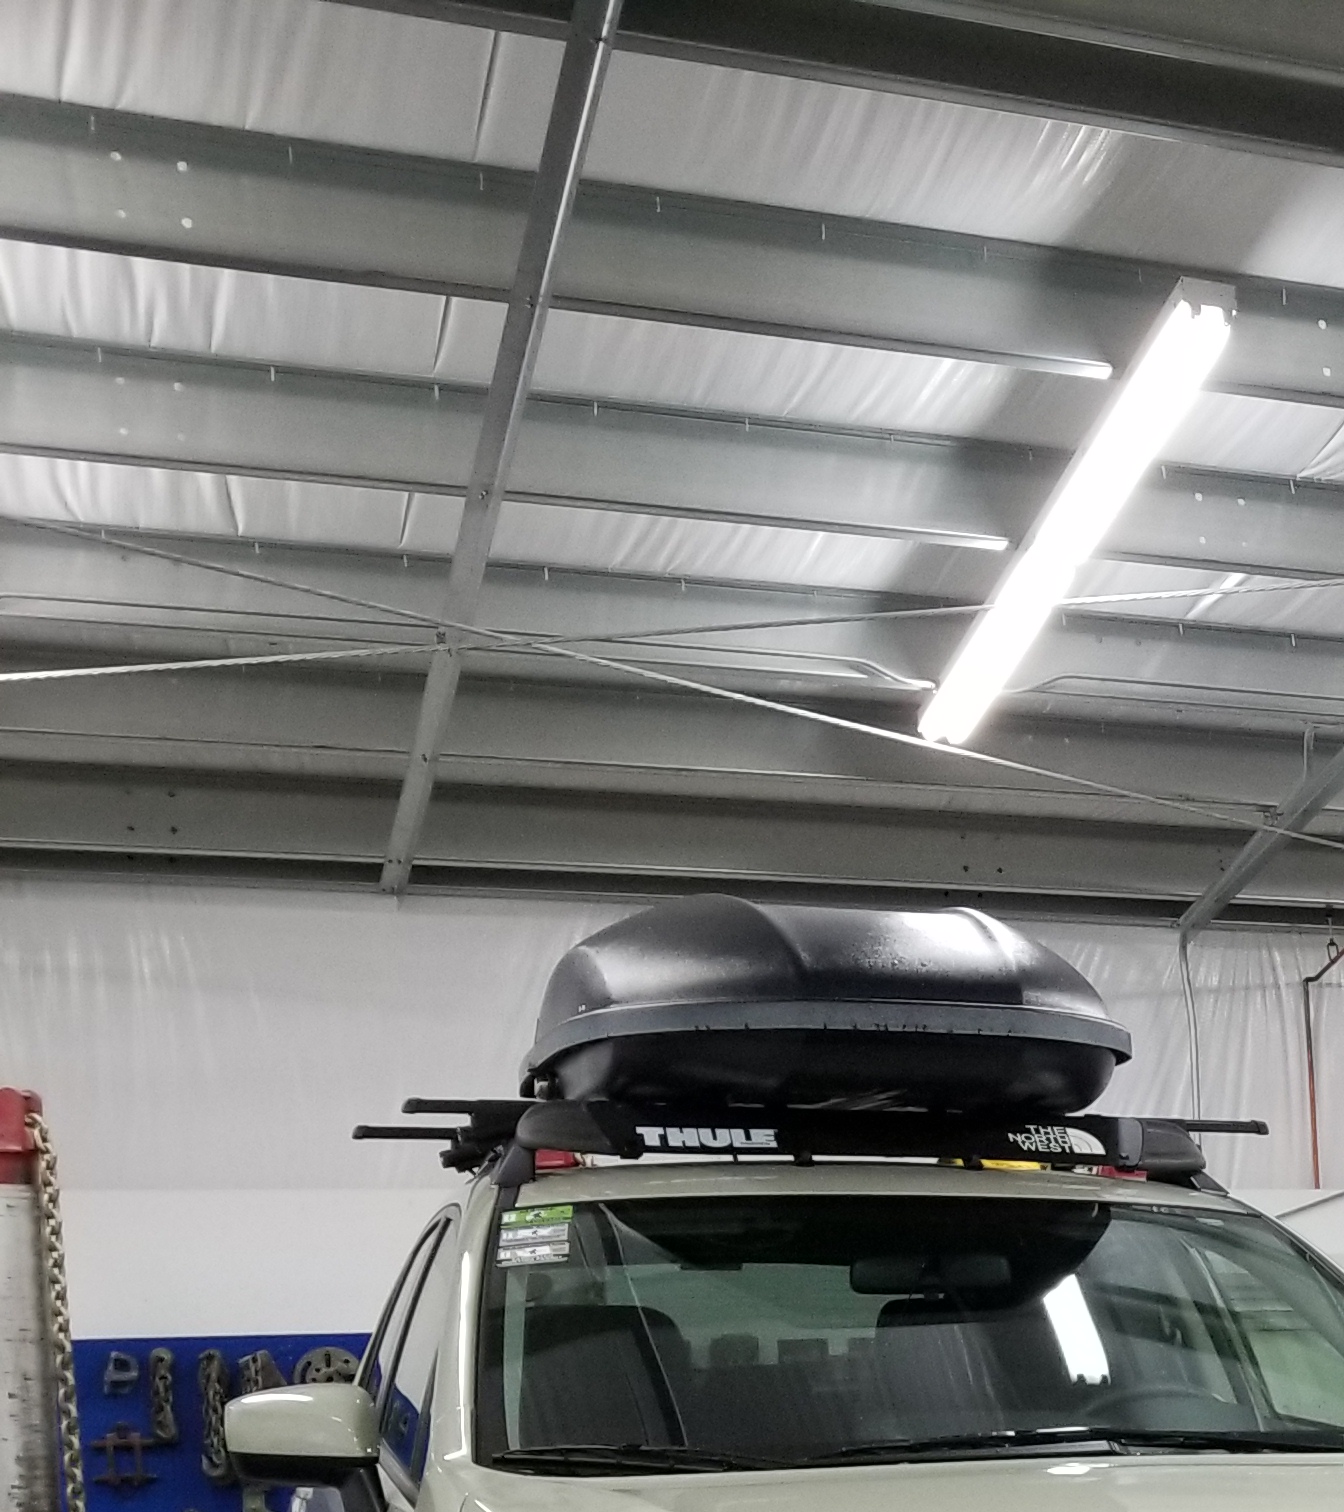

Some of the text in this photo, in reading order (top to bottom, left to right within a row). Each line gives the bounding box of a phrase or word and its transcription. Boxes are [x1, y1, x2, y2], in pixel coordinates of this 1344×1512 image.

[1025, 1125, 1066, 1135] THE
[635, 1126, 778, 1148] THULE
[1007, 1132, 1072, 1147] NORTH
[1019, 1142, 1071, 1153] WEST
